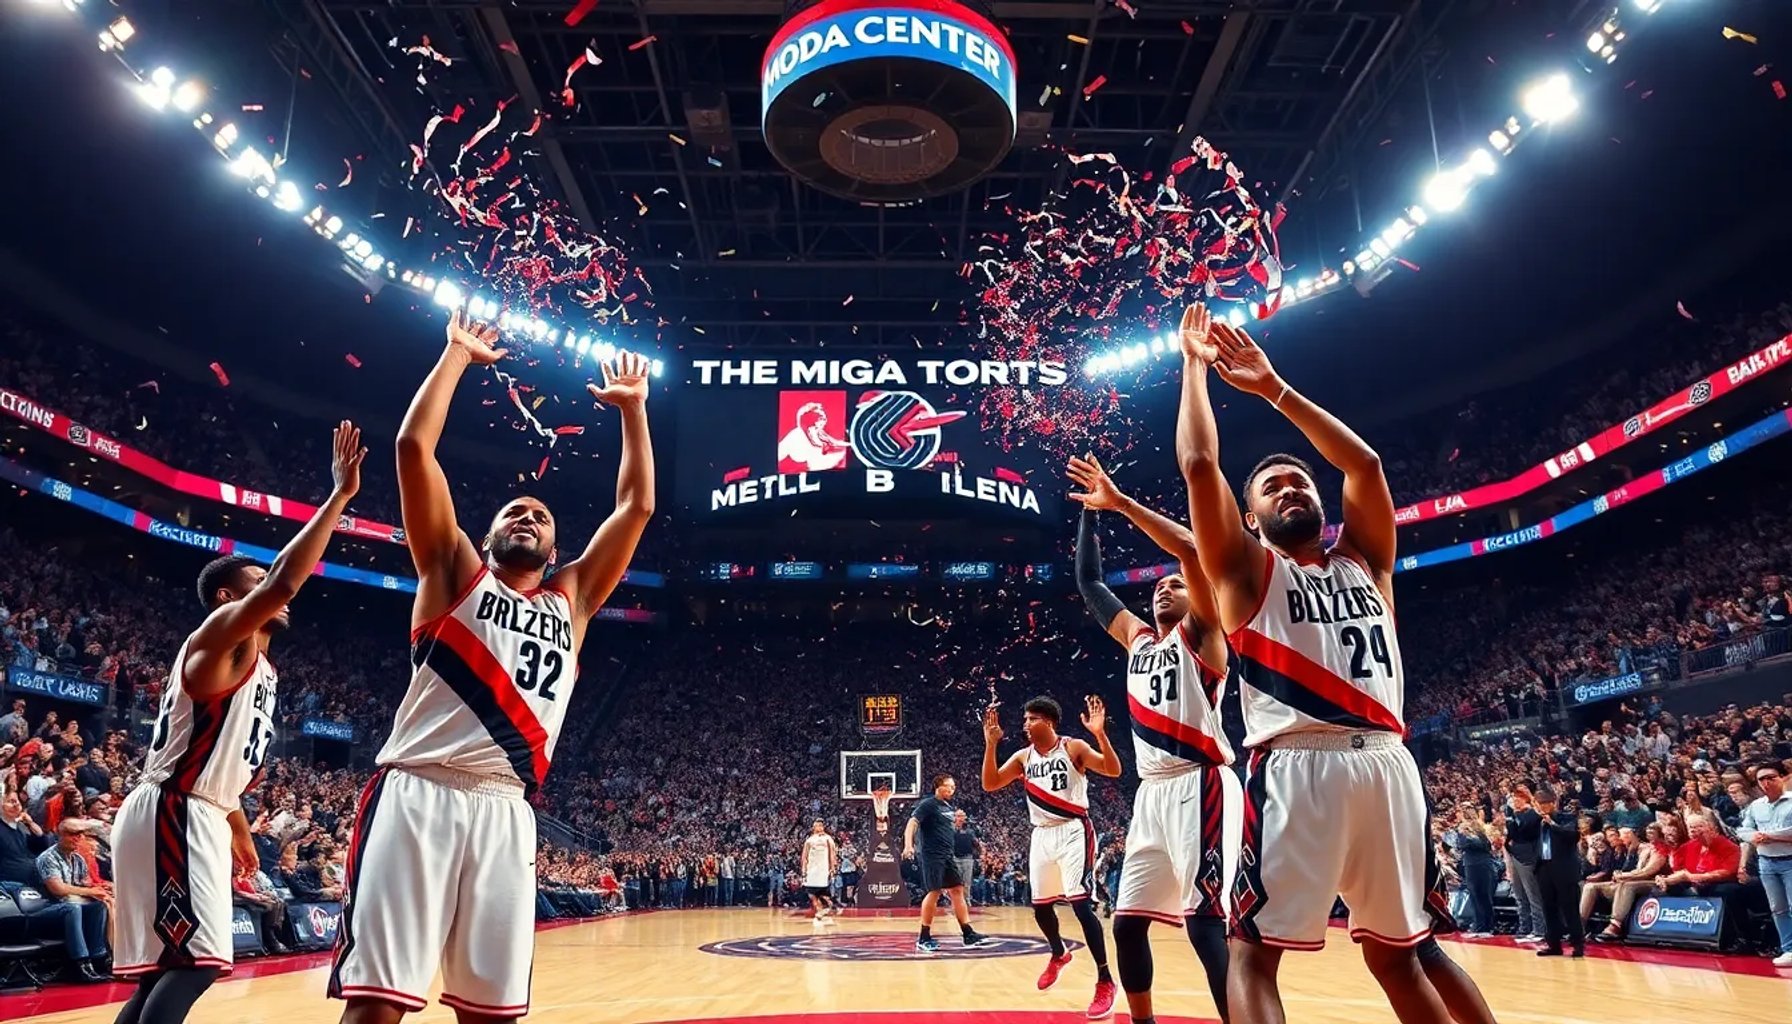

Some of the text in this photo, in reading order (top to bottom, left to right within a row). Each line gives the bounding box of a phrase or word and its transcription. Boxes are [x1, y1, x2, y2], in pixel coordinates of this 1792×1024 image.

[764, 16, 1001, 88] MODA CENTER
[693, 359, 1068, 386] THE MIGA TORTS
[866, 469, 894, 492] B
[515, 640, 563, 702] 32
[1341, 624, 1393, 679] 24
